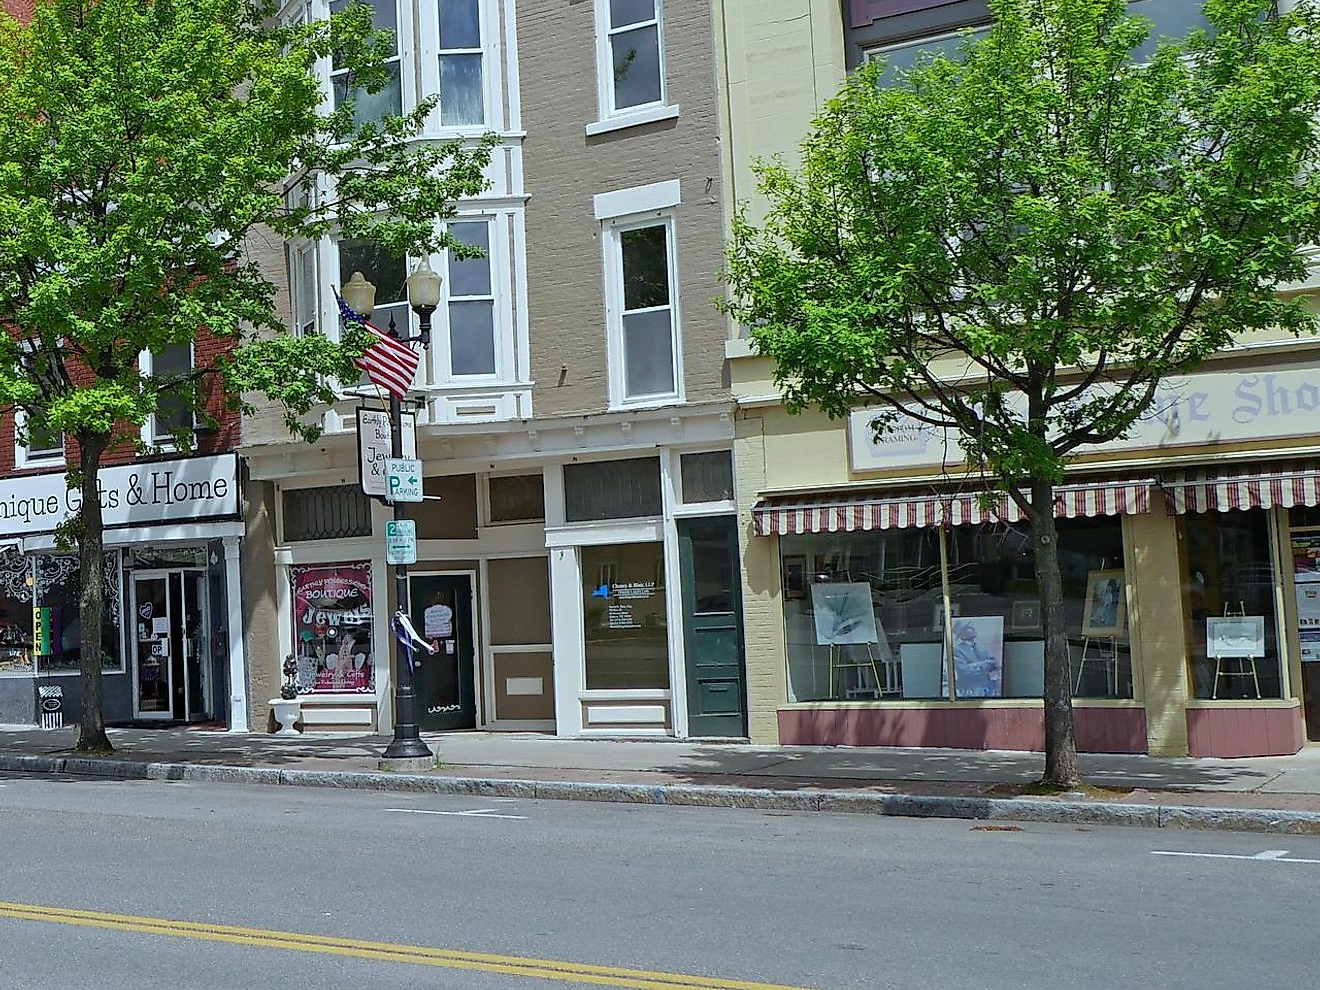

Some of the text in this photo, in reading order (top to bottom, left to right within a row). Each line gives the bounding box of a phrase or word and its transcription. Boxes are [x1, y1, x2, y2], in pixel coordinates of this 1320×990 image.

[371, 462, 380, 476] &
[391, 464, 415, 473] PUBLIC
[65, 478, 119, 513] Gts
[126, 473, 148, 506] &
[151, 471, 228, 505] Home
[389, 475, 419, 497] PARKING
[389, 523, 396, 535] 2
[306, 588, 359, 600] BOUTIQUE
